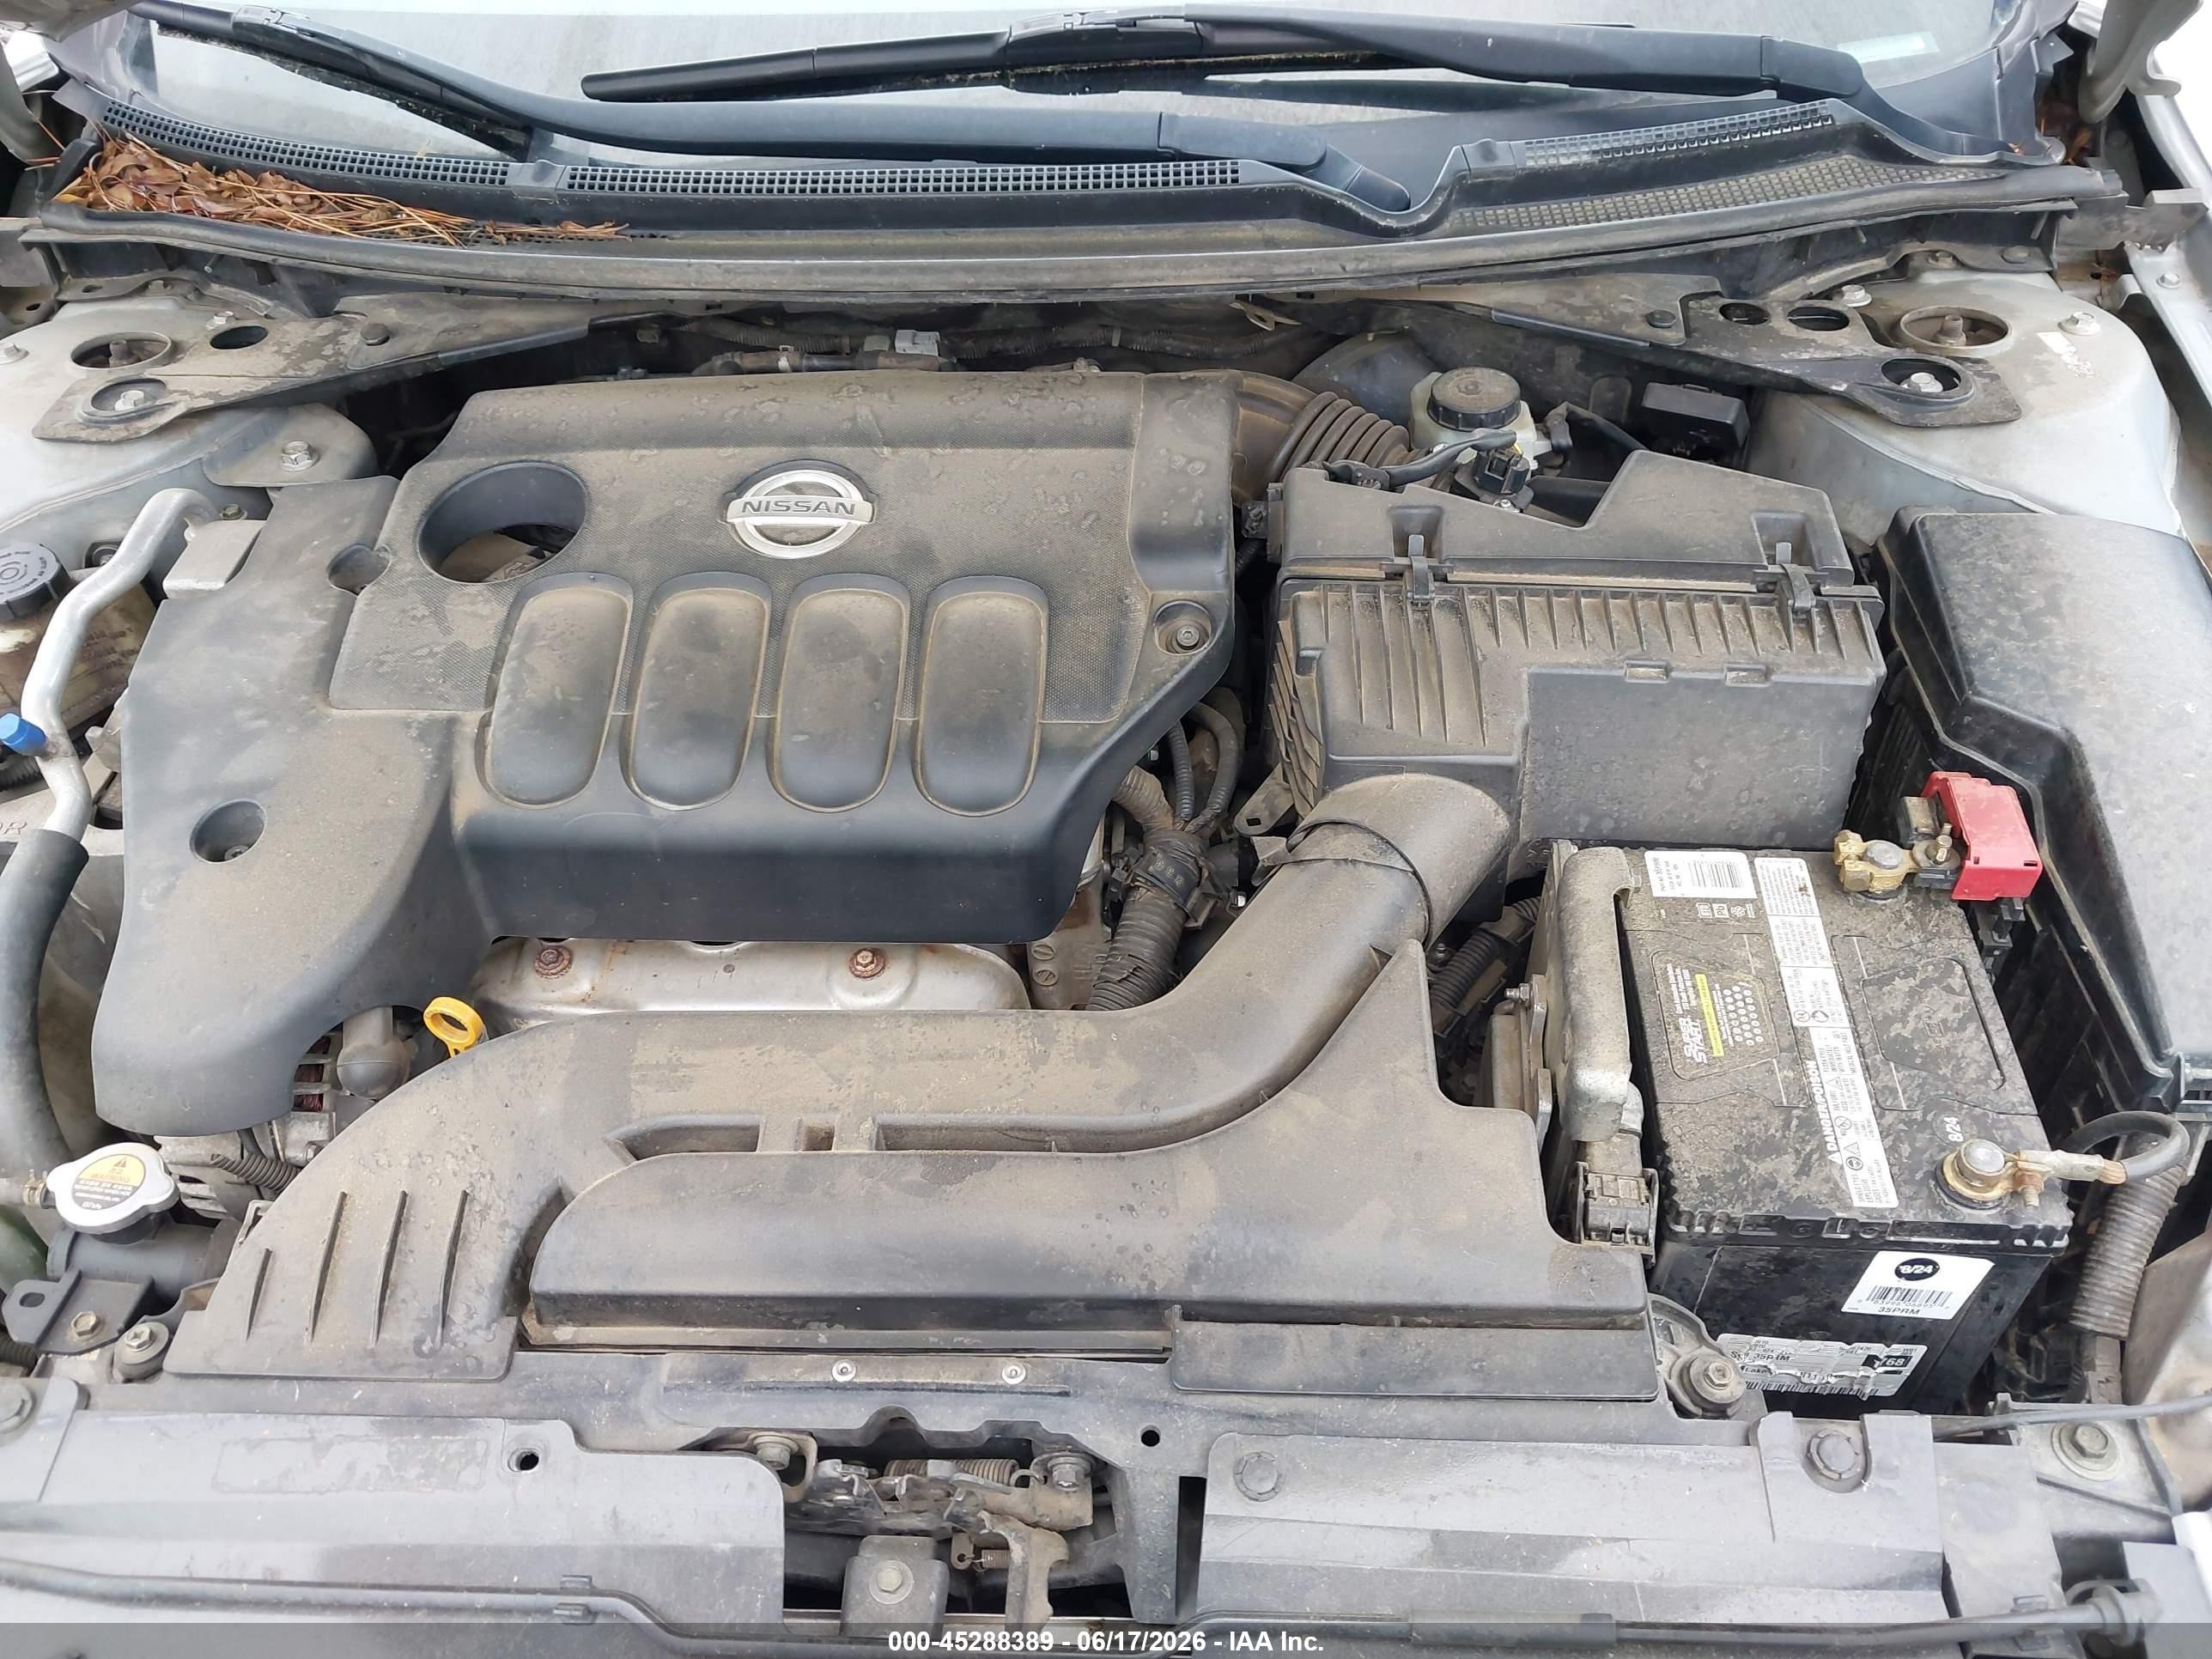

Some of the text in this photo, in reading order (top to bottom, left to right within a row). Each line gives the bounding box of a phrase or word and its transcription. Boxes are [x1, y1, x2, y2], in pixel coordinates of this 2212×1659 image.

[741, 500, 855, 516] NISSAN
[1679, 1017, 1693, 1057] SUPER
[1689, 1018, 1708, 1064] START
[1805, 1060, 1839, 1151] DANGER/POISON
[1943, 1116, 1964, 1142] 8/24
[1900, 1265, 1933, 1274] 8/24
[1877, 1306, 1921, 1316] 35PRM
